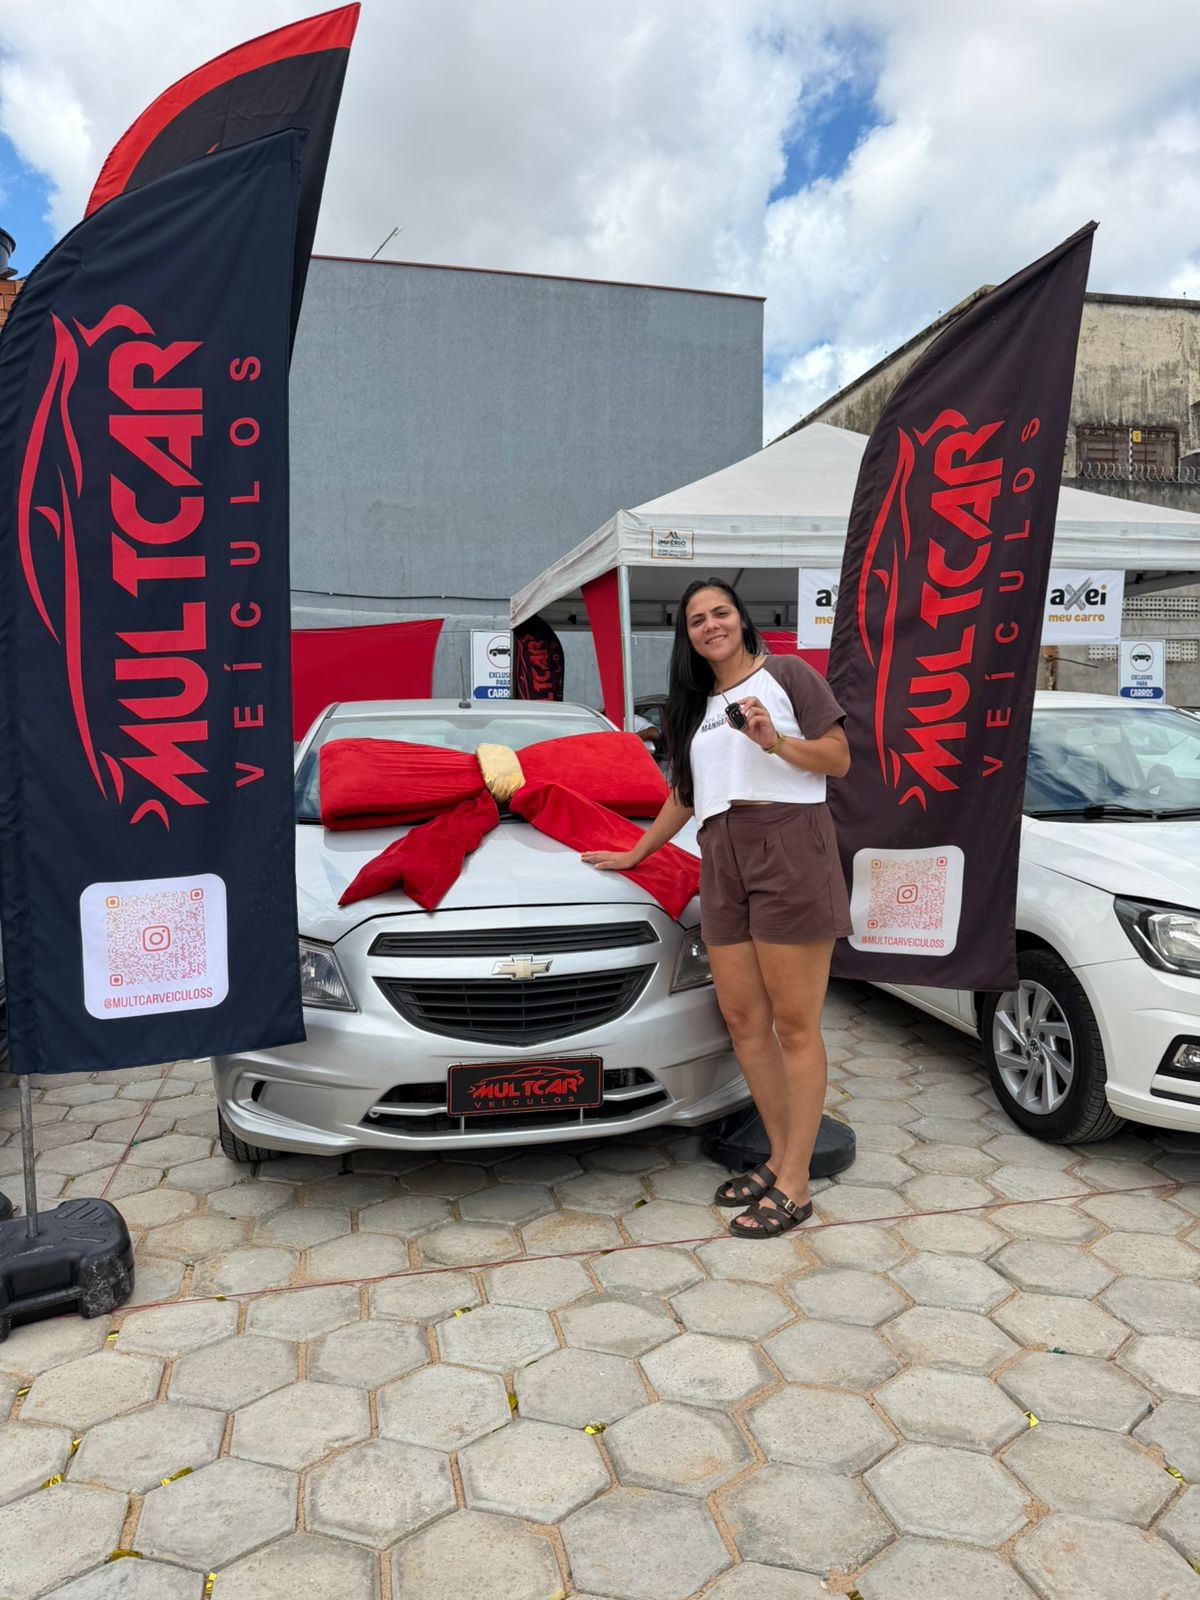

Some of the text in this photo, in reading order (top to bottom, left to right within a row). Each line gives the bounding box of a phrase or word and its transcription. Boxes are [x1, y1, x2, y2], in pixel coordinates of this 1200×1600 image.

[107, 341, 209, 807] MULTCAR
[225, 356, 264, 788] VEÍCULOS
[900, 421, 1004, 794] MULTCAR
[980, 417, 1040, 777] VEÍCULOS
[815, 616, 833, 624] me
[1048, 613, 1105, 622] meu carro
[488, 688, 510, 698] CARR
[1130, 688, 1154, 697] CARROS
[861, 936, 945, 948] @MULTCARVEICULOSS
[104, 987, 213, 1009] @MULTCARVEICULOSS
[472, 1078, 578, 1099] MULTCAR
